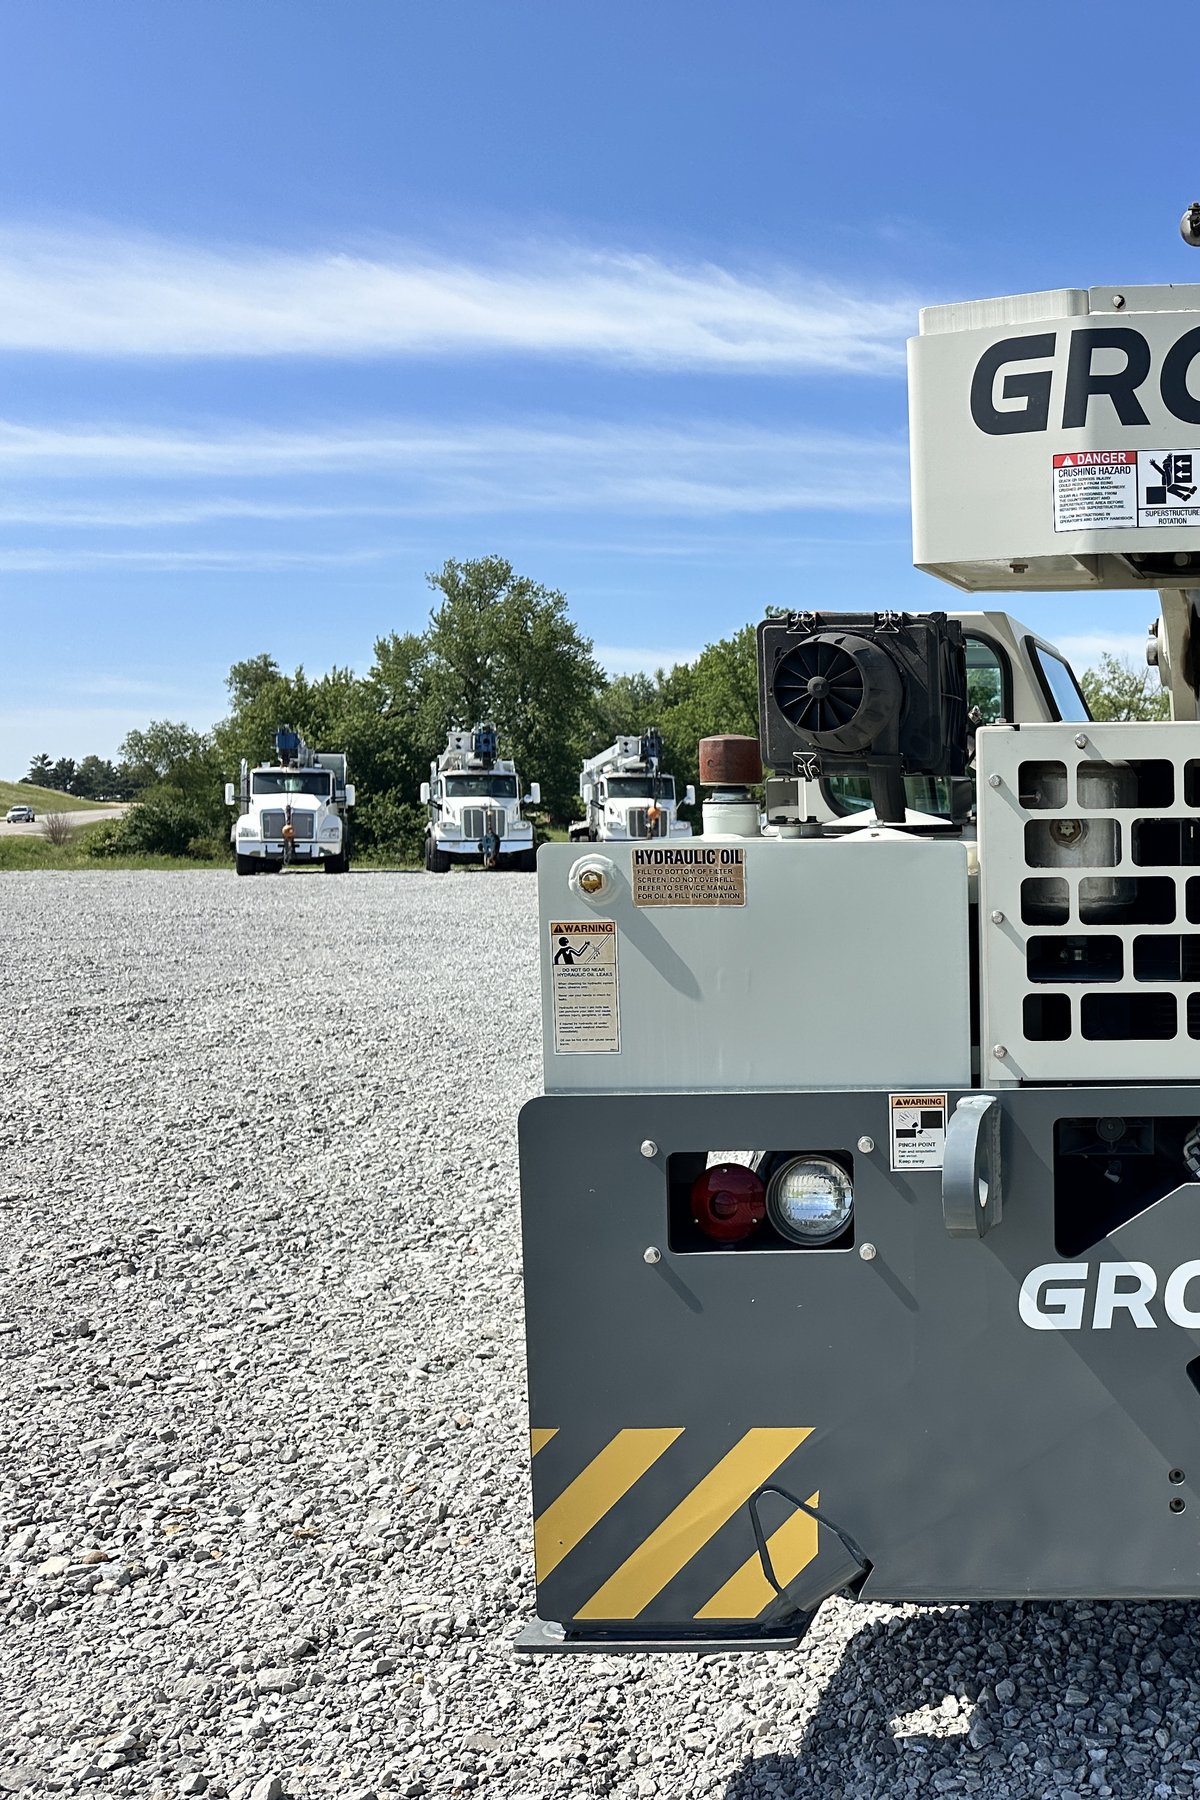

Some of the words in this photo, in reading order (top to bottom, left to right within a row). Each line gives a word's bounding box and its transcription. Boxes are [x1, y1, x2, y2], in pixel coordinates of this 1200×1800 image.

[1077, 453, 1126, 464] DANGER
[1059, 467, 1096, 477] CRUSHING
[1099, 466, 1131, 475] HAZARD
[635, 850, 715, 865] HYDRAULIC
[721, 849, 742, 864] OIL
[564, 924, 612, 933] WARNING
